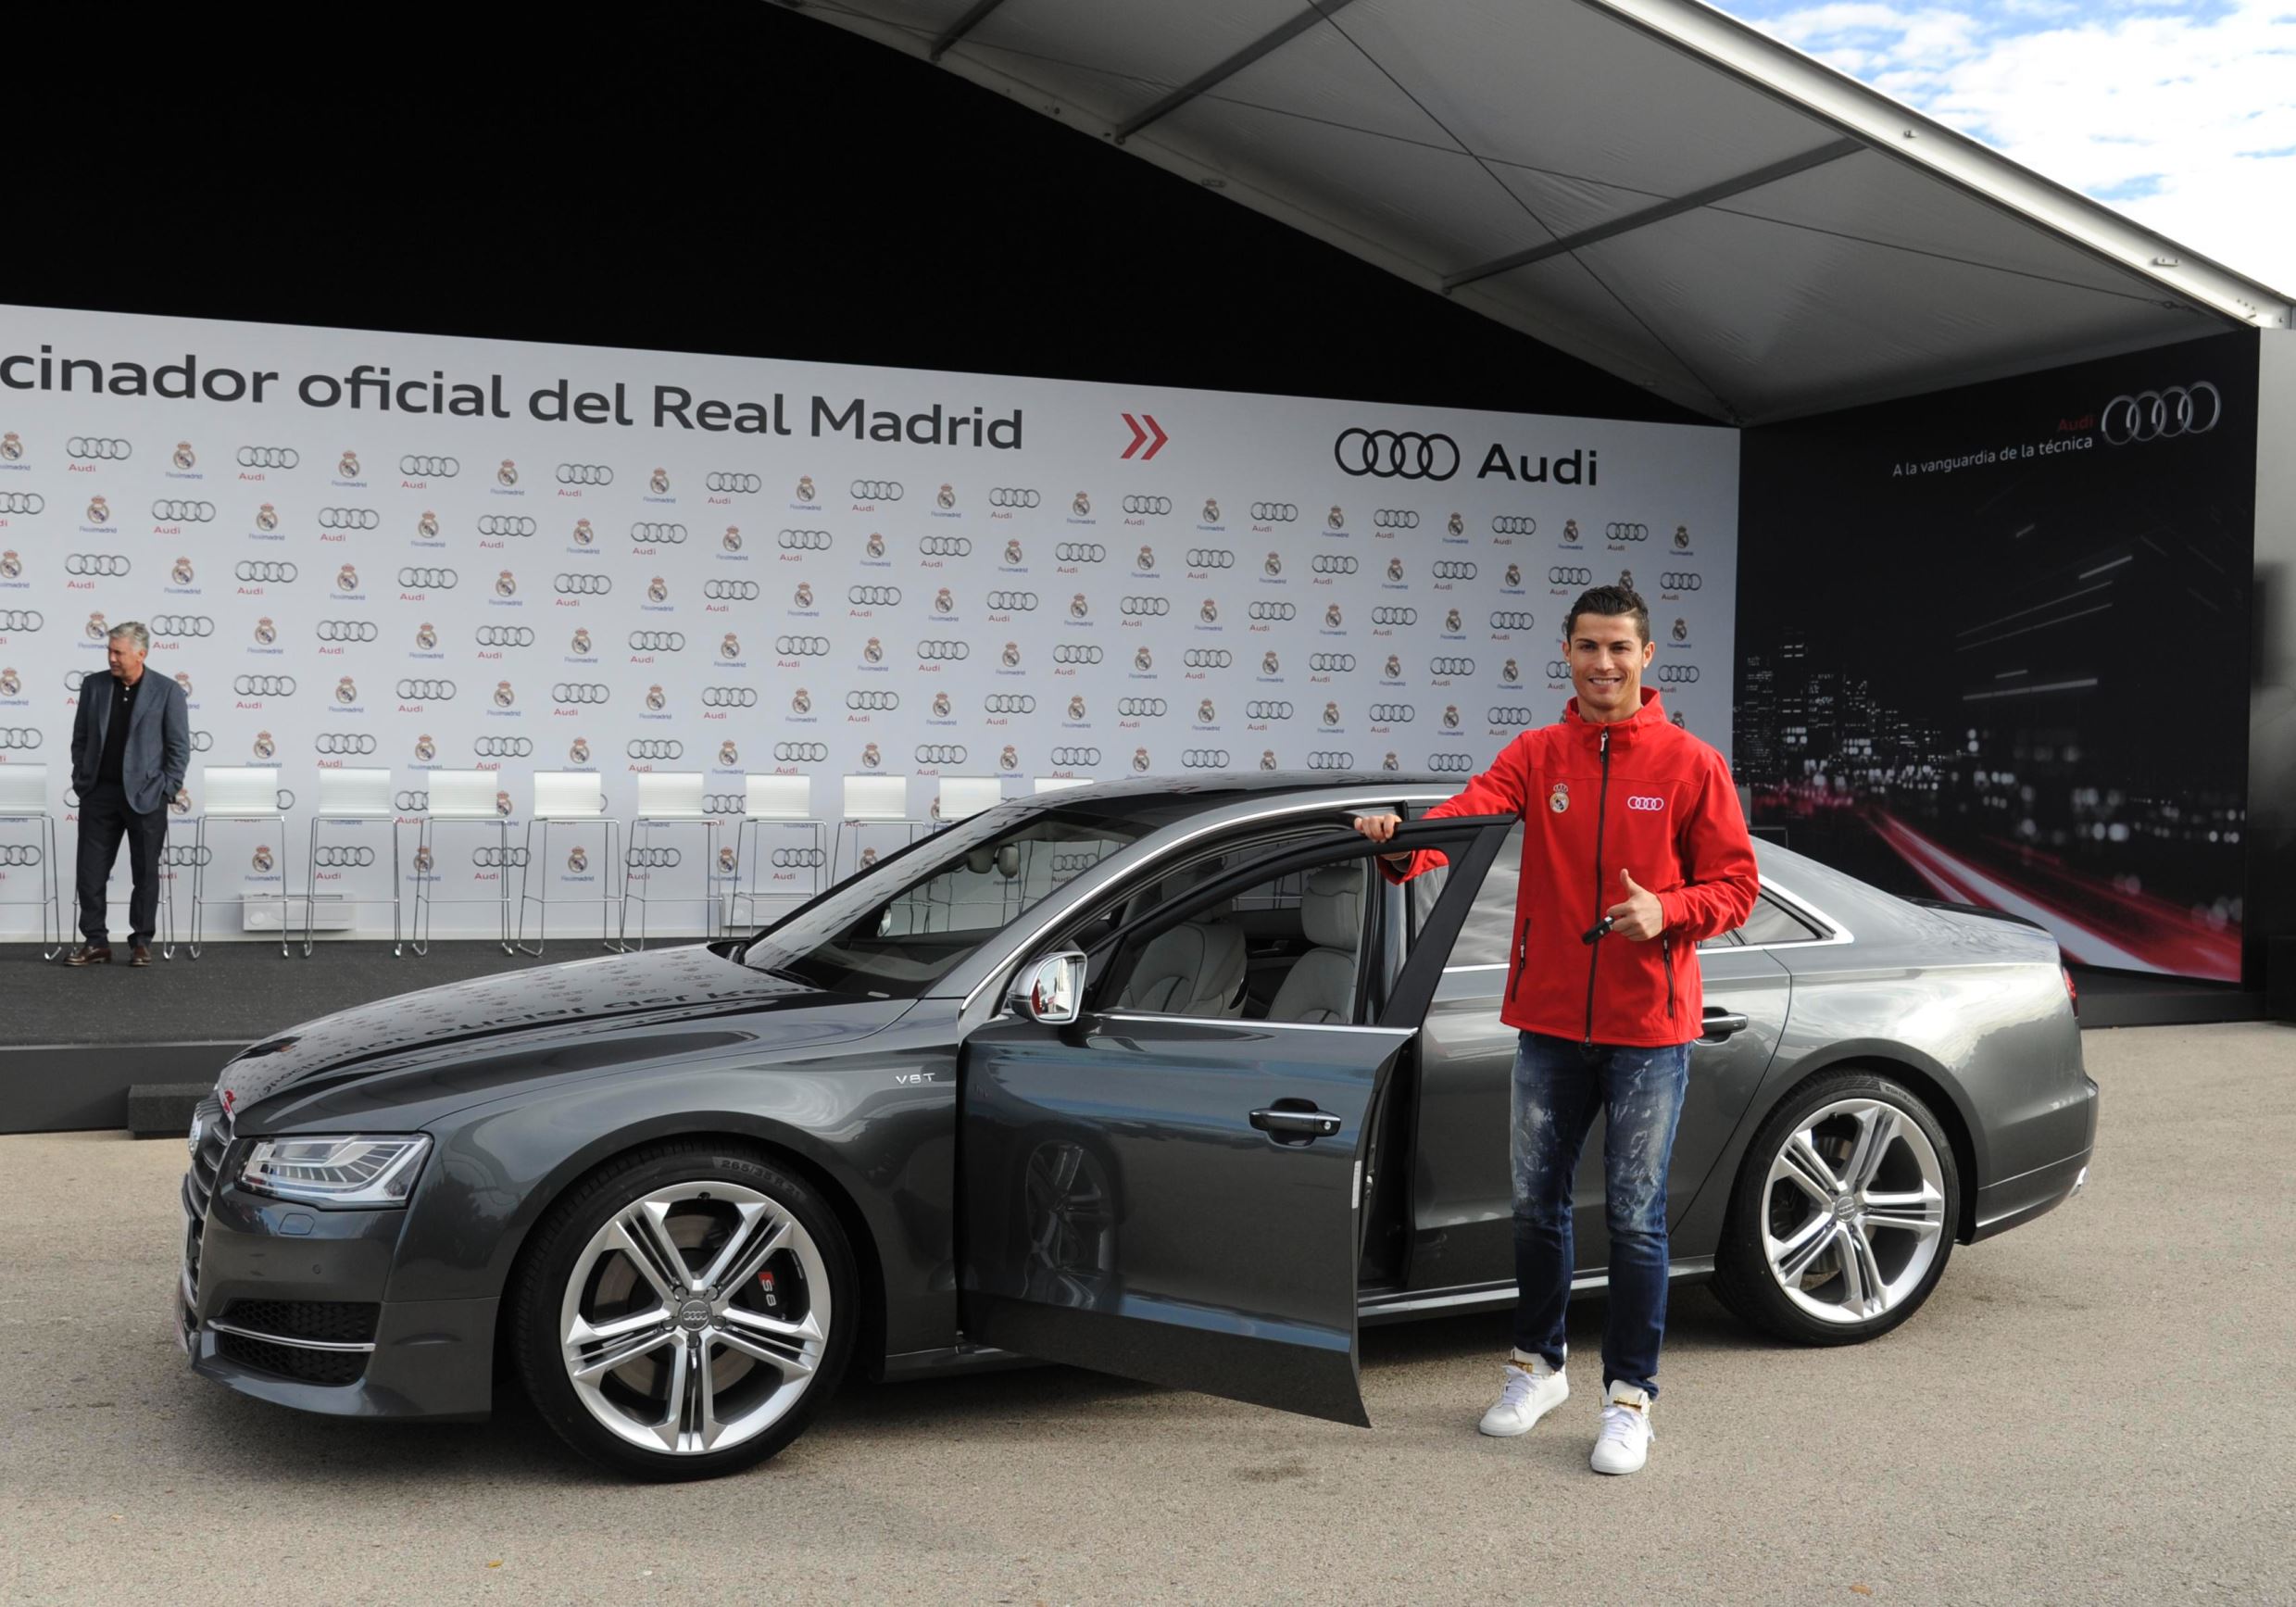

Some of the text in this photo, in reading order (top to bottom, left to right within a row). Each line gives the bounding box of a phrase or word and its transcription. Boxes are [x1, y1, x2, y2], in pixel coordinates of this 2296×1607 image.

[299, 365, 510, 418] oficial
[529, 379, 633, 425] del
[655, 385, 791, 435] Real
[811, 395, 1022, 449] Madrid
[2057, 416, 2095, 432] Audi
[1892, 436, 2093, 476] A la vanguardia de la técnica
[69, 464, 96, 472] Audi
[1477, 444, 1598, 485] Audi
[239, 472, 265, 481] Audi
[402, 481, 426, 489] Audi
[708, 496, 731, 505] Audi
[852, 504, 874, 512] Audi
[154, 526, 181, 534] Audi
[320, 534, 345, 542] Audi
[480, 540, 504, 548] Audi
[68, 581, 94, 589] Audi
[237, 586, 263, 595] Audi
[400, 593, 425, 601] Audi
[556, 598, 580, 607] Audi
[706, 604, 729, 612] Audi
[896, 1073, 935, 1085] V8T
[761, 1278, 776, 1307] S8
